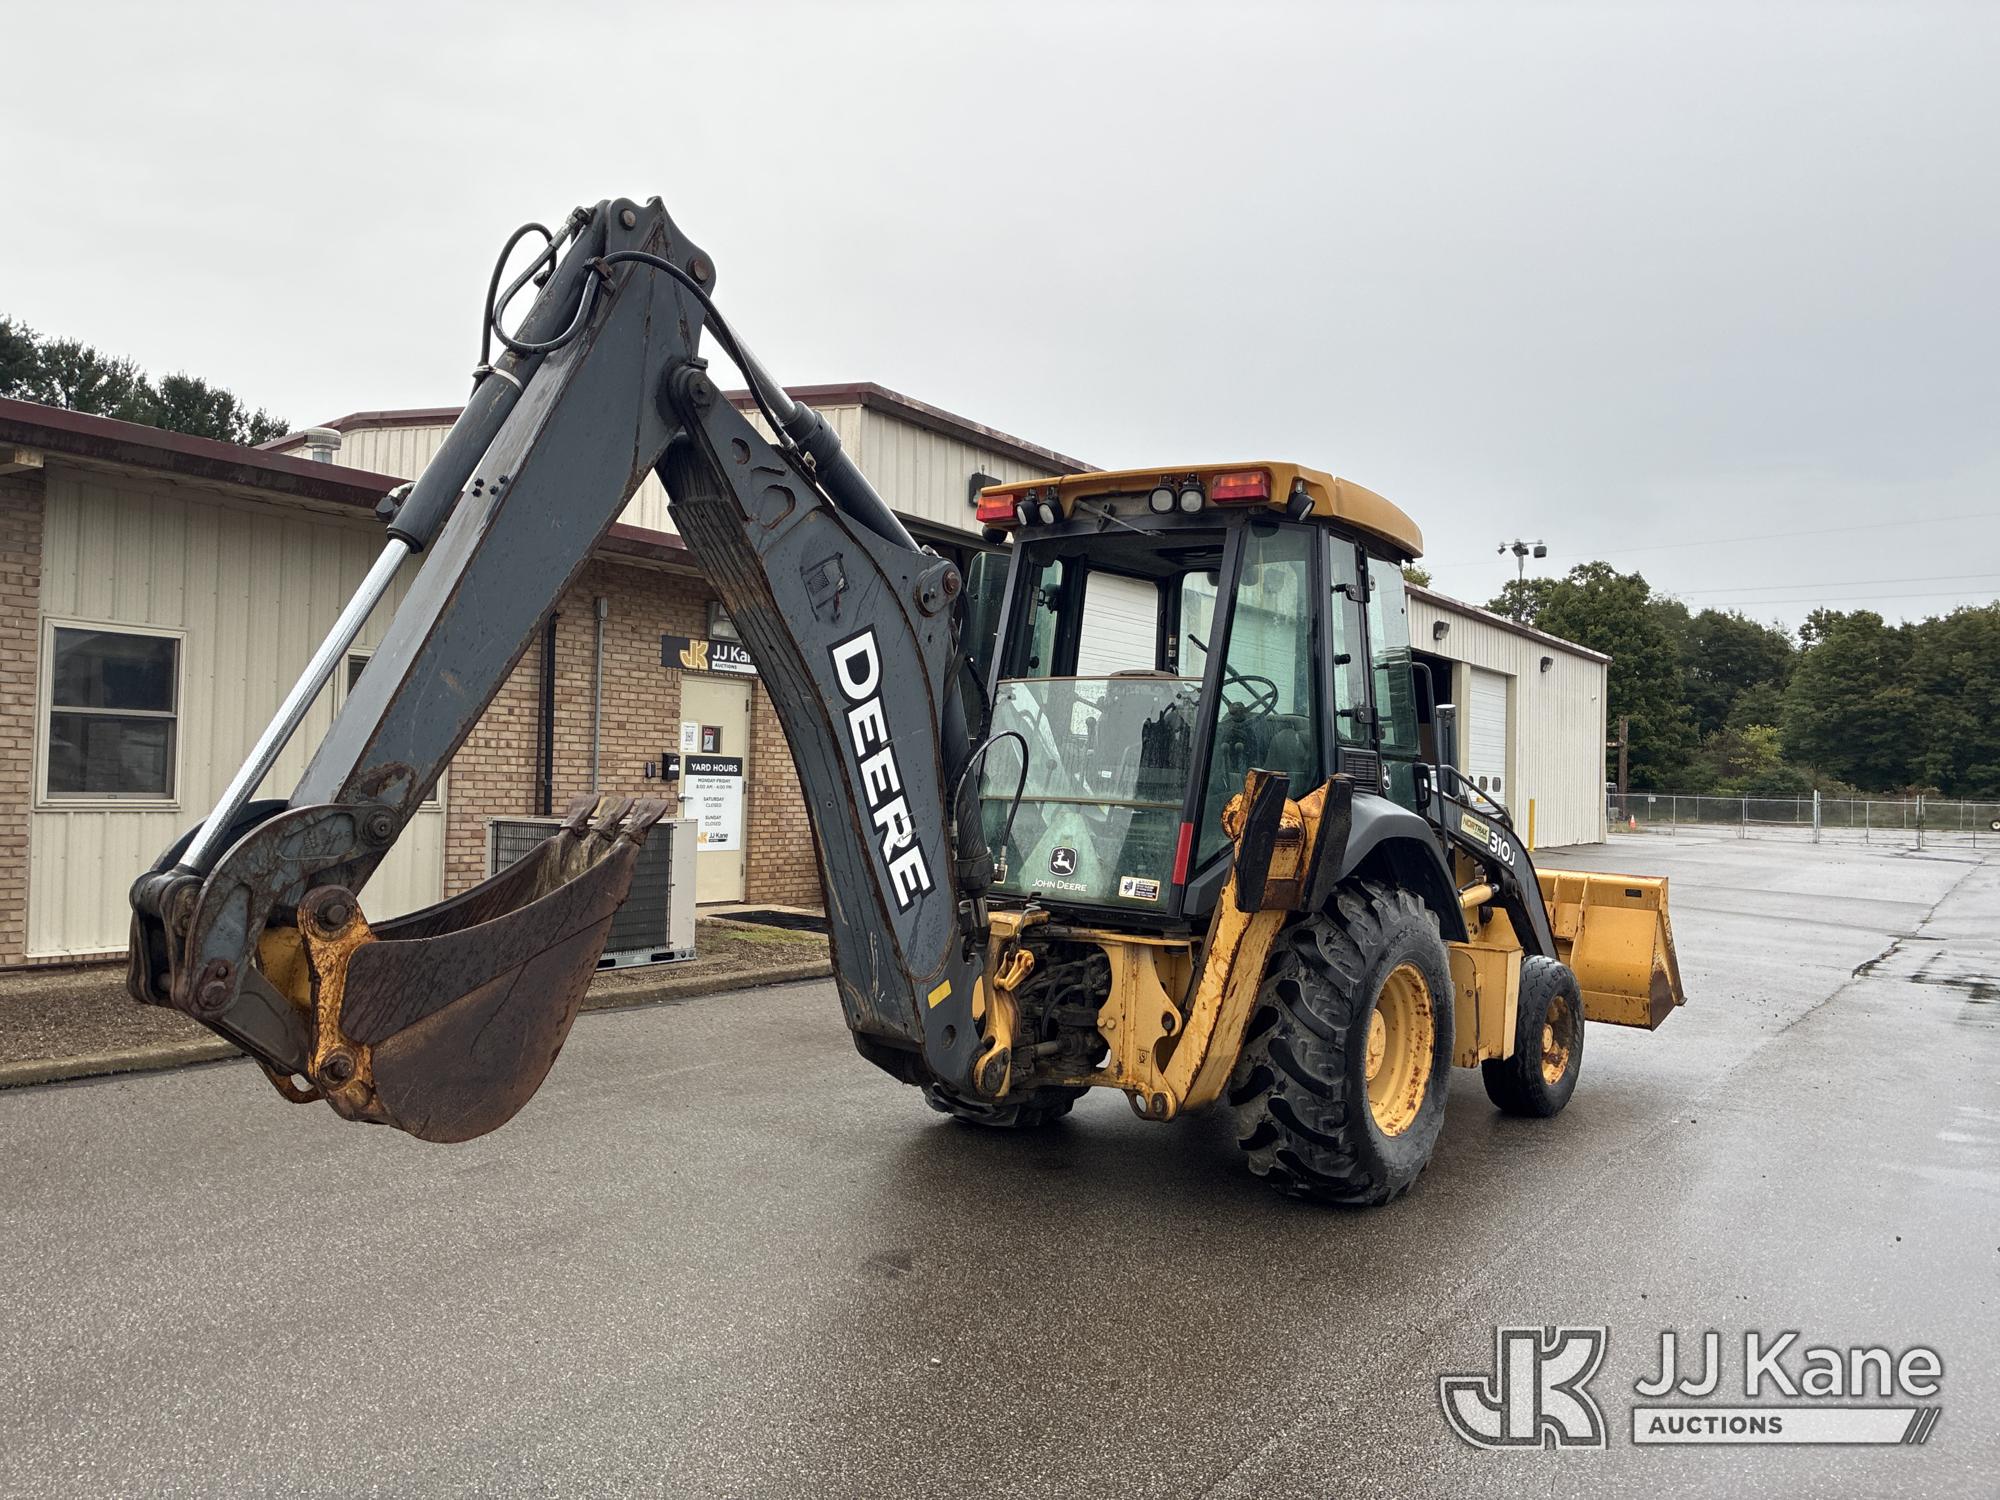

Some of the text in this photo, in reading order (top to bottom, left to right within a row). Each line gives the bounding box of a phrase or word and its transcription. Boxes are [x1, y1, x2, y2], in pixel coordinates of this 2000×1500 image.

[712, 644, 727, 660] JJ
[691, 763, 738, 773] YARD HOURS
[831, 629, 932, 908] DEERE
[1489, 830, 1516, 867] 310J
[1031, 878, 1088, 892] JOHN DEERE
